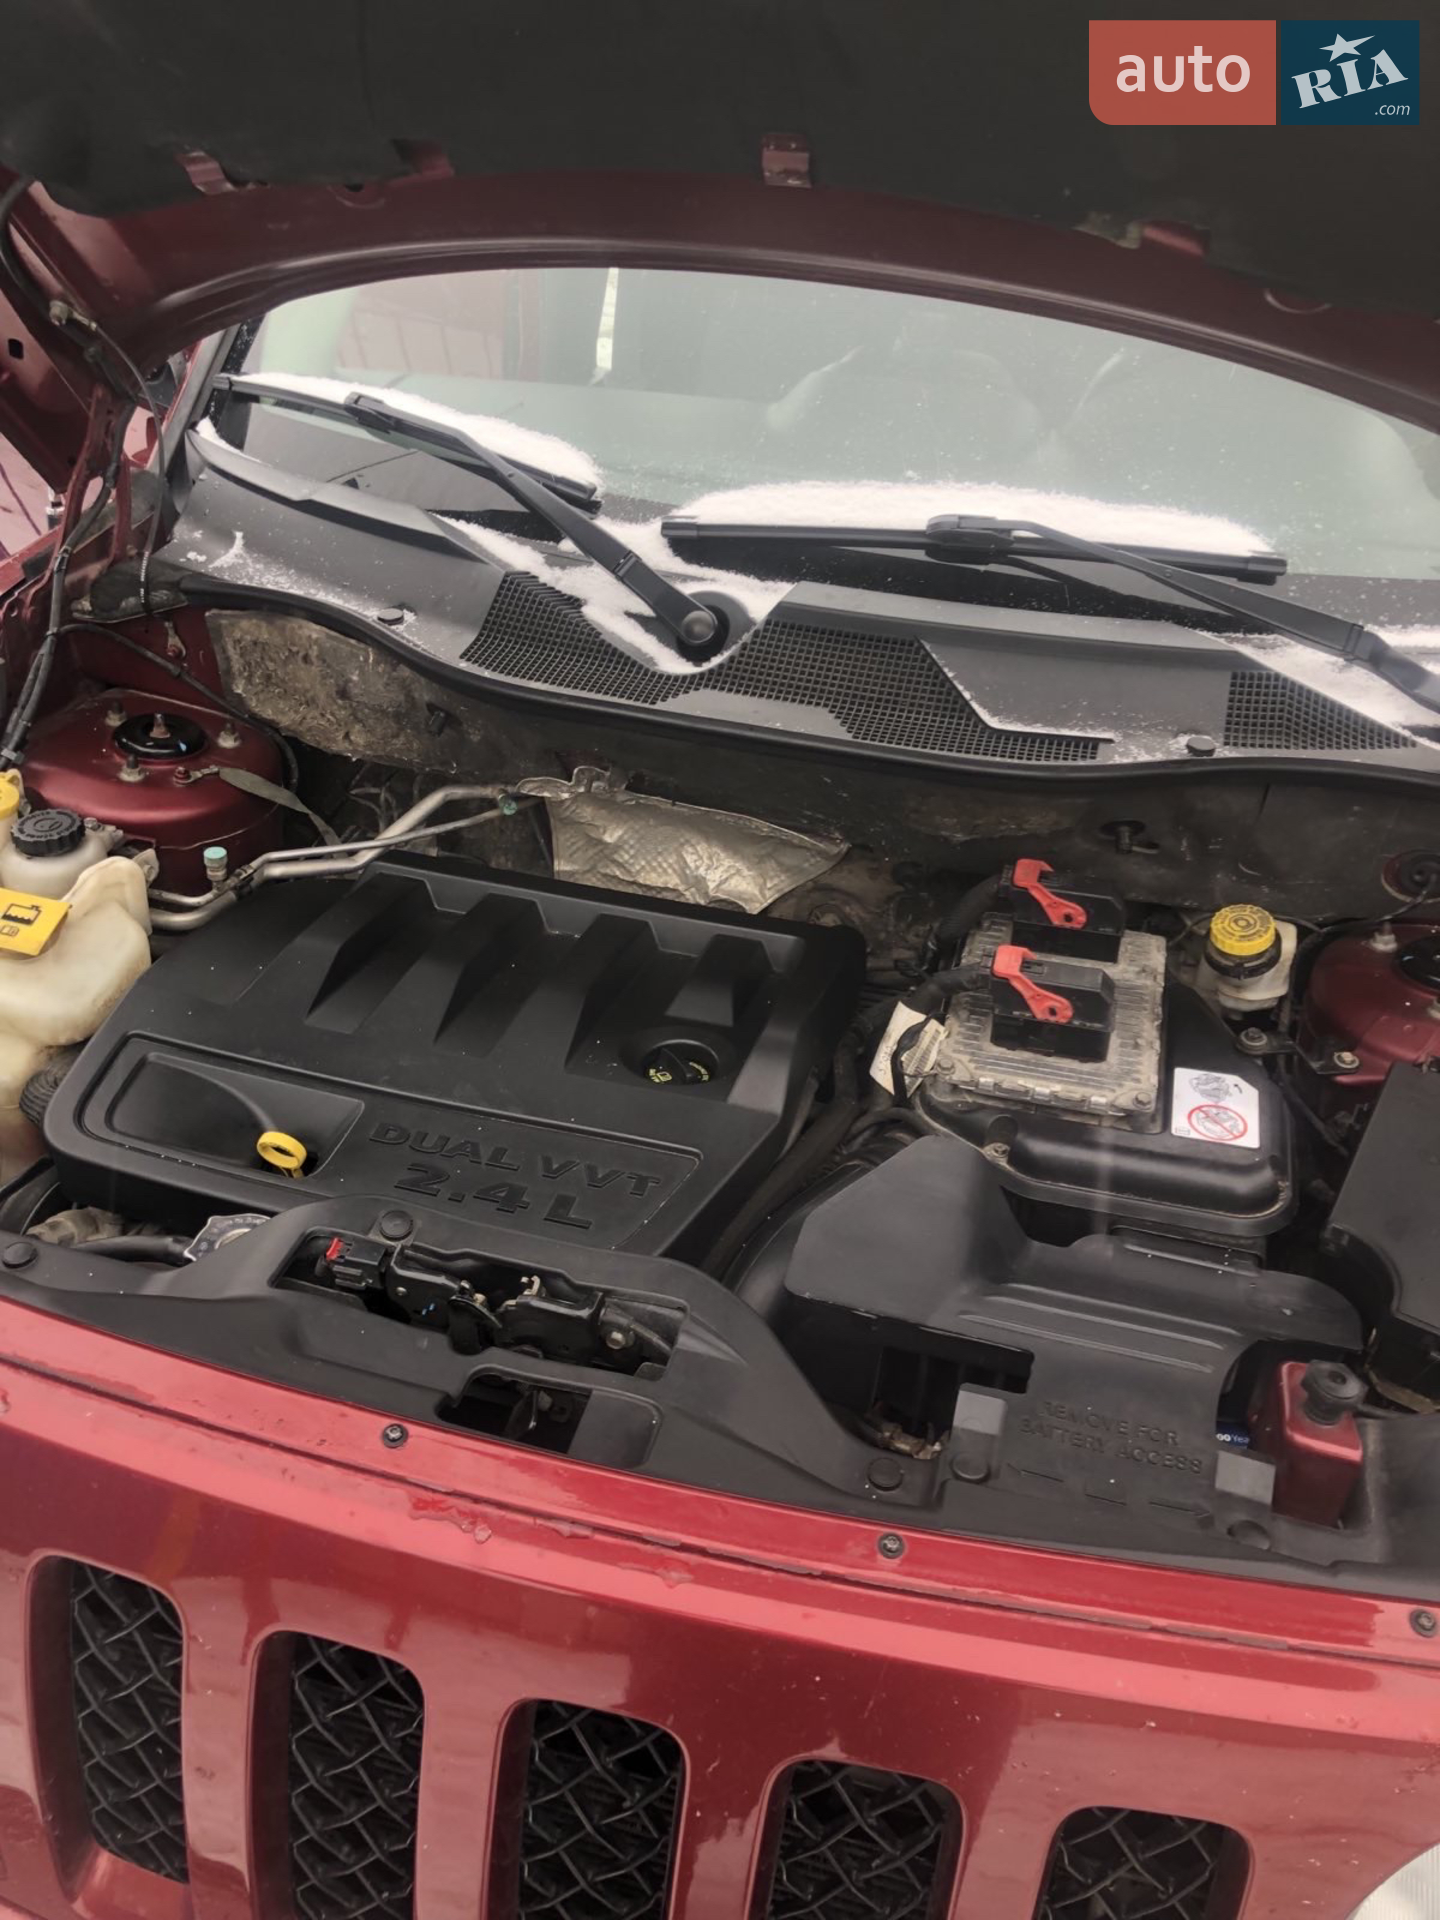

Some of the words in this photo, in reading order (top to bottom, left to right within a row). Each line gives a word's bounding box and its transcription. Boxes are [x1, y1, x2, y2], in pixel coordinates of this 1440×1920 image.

[369, 1122, 520, 1171] DUAL
[542, 1155, 661, 1196] VVT
[543, 1194, 592, 1229] L
[1020, 1416, 1104, 1454] BATTERY
[1114, 1445, 1202, 1474] ACCESS
[1038, 1401, 1129, 1436] REMOVE
[1136, 1423, 1180, 1446] FOR
